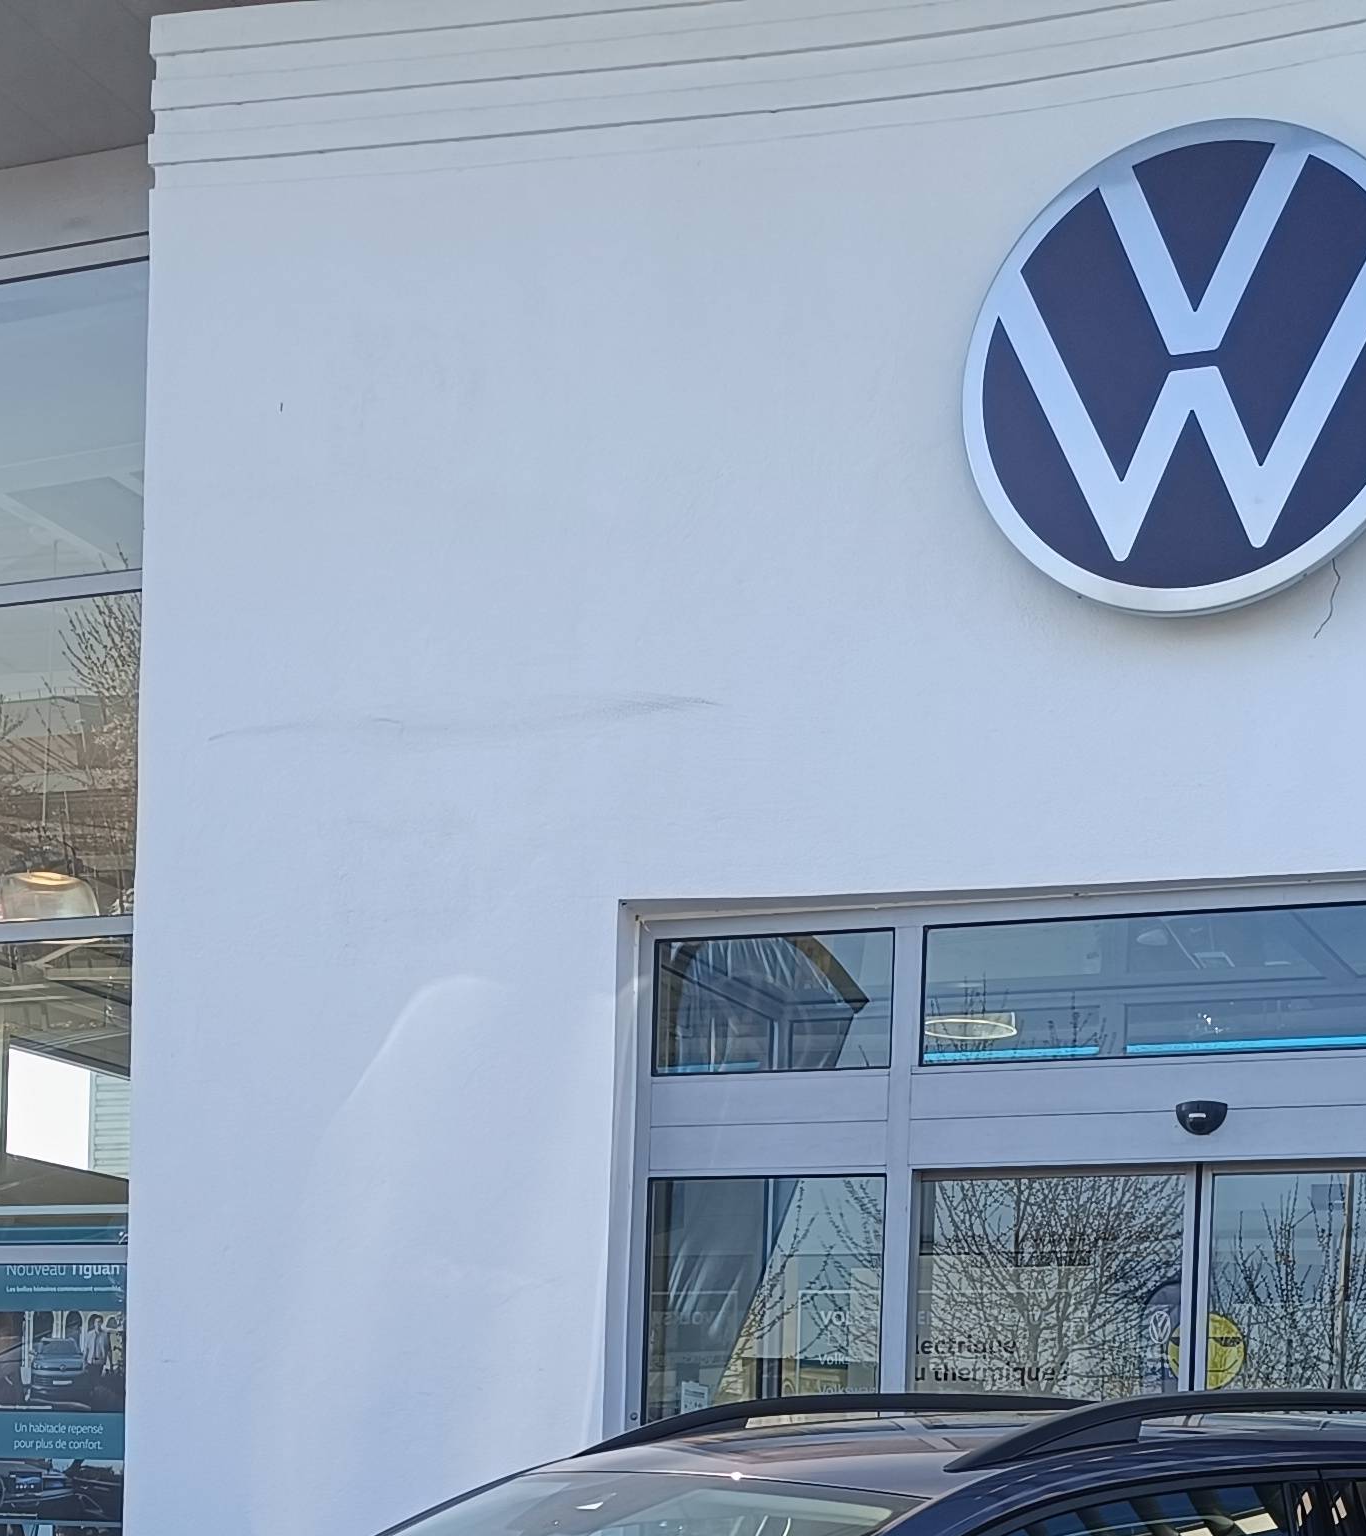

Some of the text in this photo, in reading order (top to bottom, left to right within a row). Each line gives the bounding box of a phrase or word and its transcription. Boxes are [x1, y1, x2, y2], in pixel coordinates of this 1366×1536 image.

[6, 1264, 66, 1277] Nouveau
[915, 1333, 1017, 1360] lectrique
[14, 1422, 27, 1434] Un
[68, 1423, 104, 1436] repensé
[14, 1439, 34, 1451] pour
[35, 1438, 53, 1451] plus
[55, 1438, 67, 1450] de
